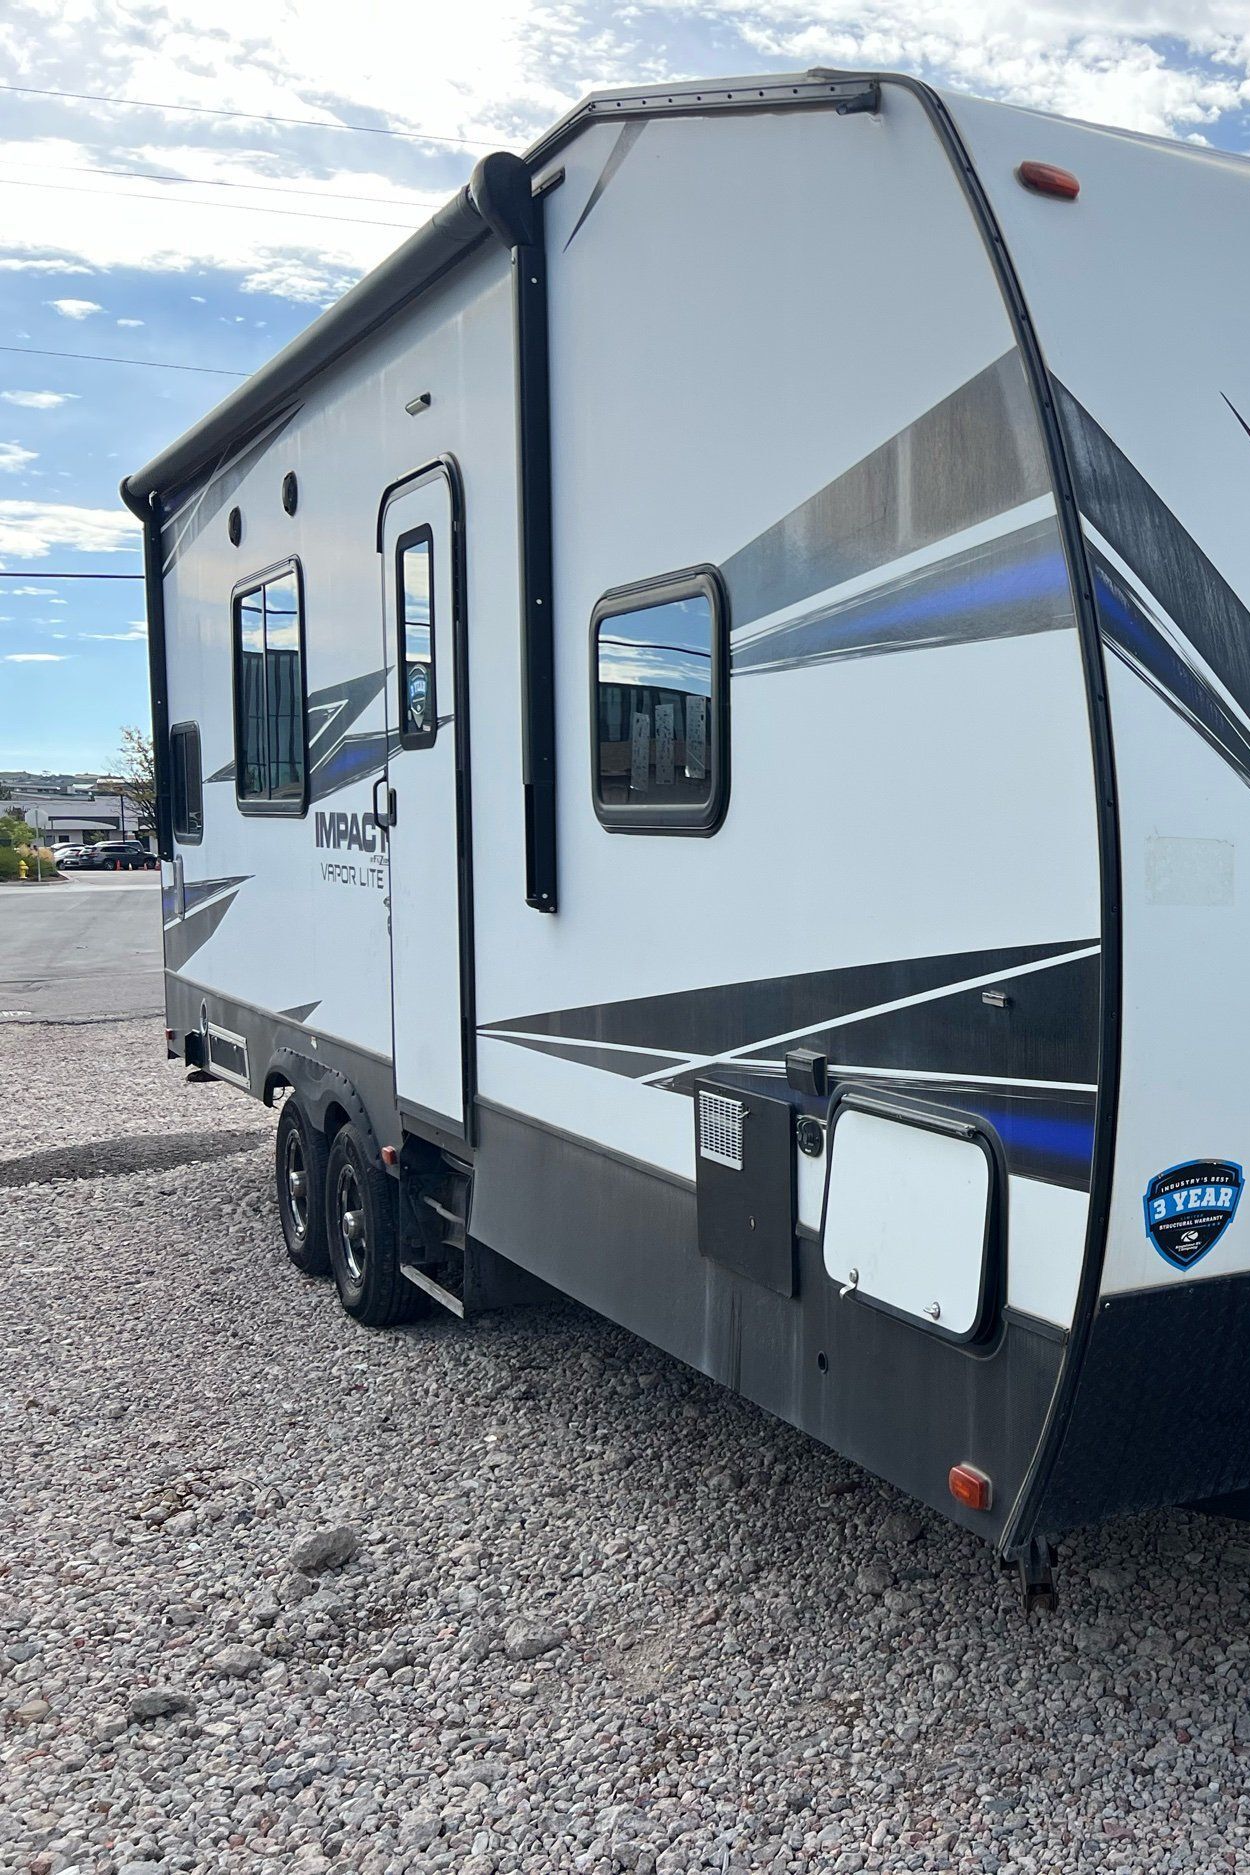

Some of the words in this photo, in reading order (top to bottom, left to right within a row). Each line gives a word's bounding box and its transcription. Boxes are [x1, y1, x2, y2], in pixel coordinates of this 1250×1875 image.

[320, 861, 357, 885] VAPOR
[359, 866, 384, 889] LITE
[1161, 1176, 1208, 1193] INDUSTRY'S
[1153, 1198, 1167, 1220] 3
[1172, 1187, 1233, 1212] YEAR
[1159, 1219, 1193, 1231] STRUCTURAL
[1194, 1214, 1224, 1225] WARRANTY
